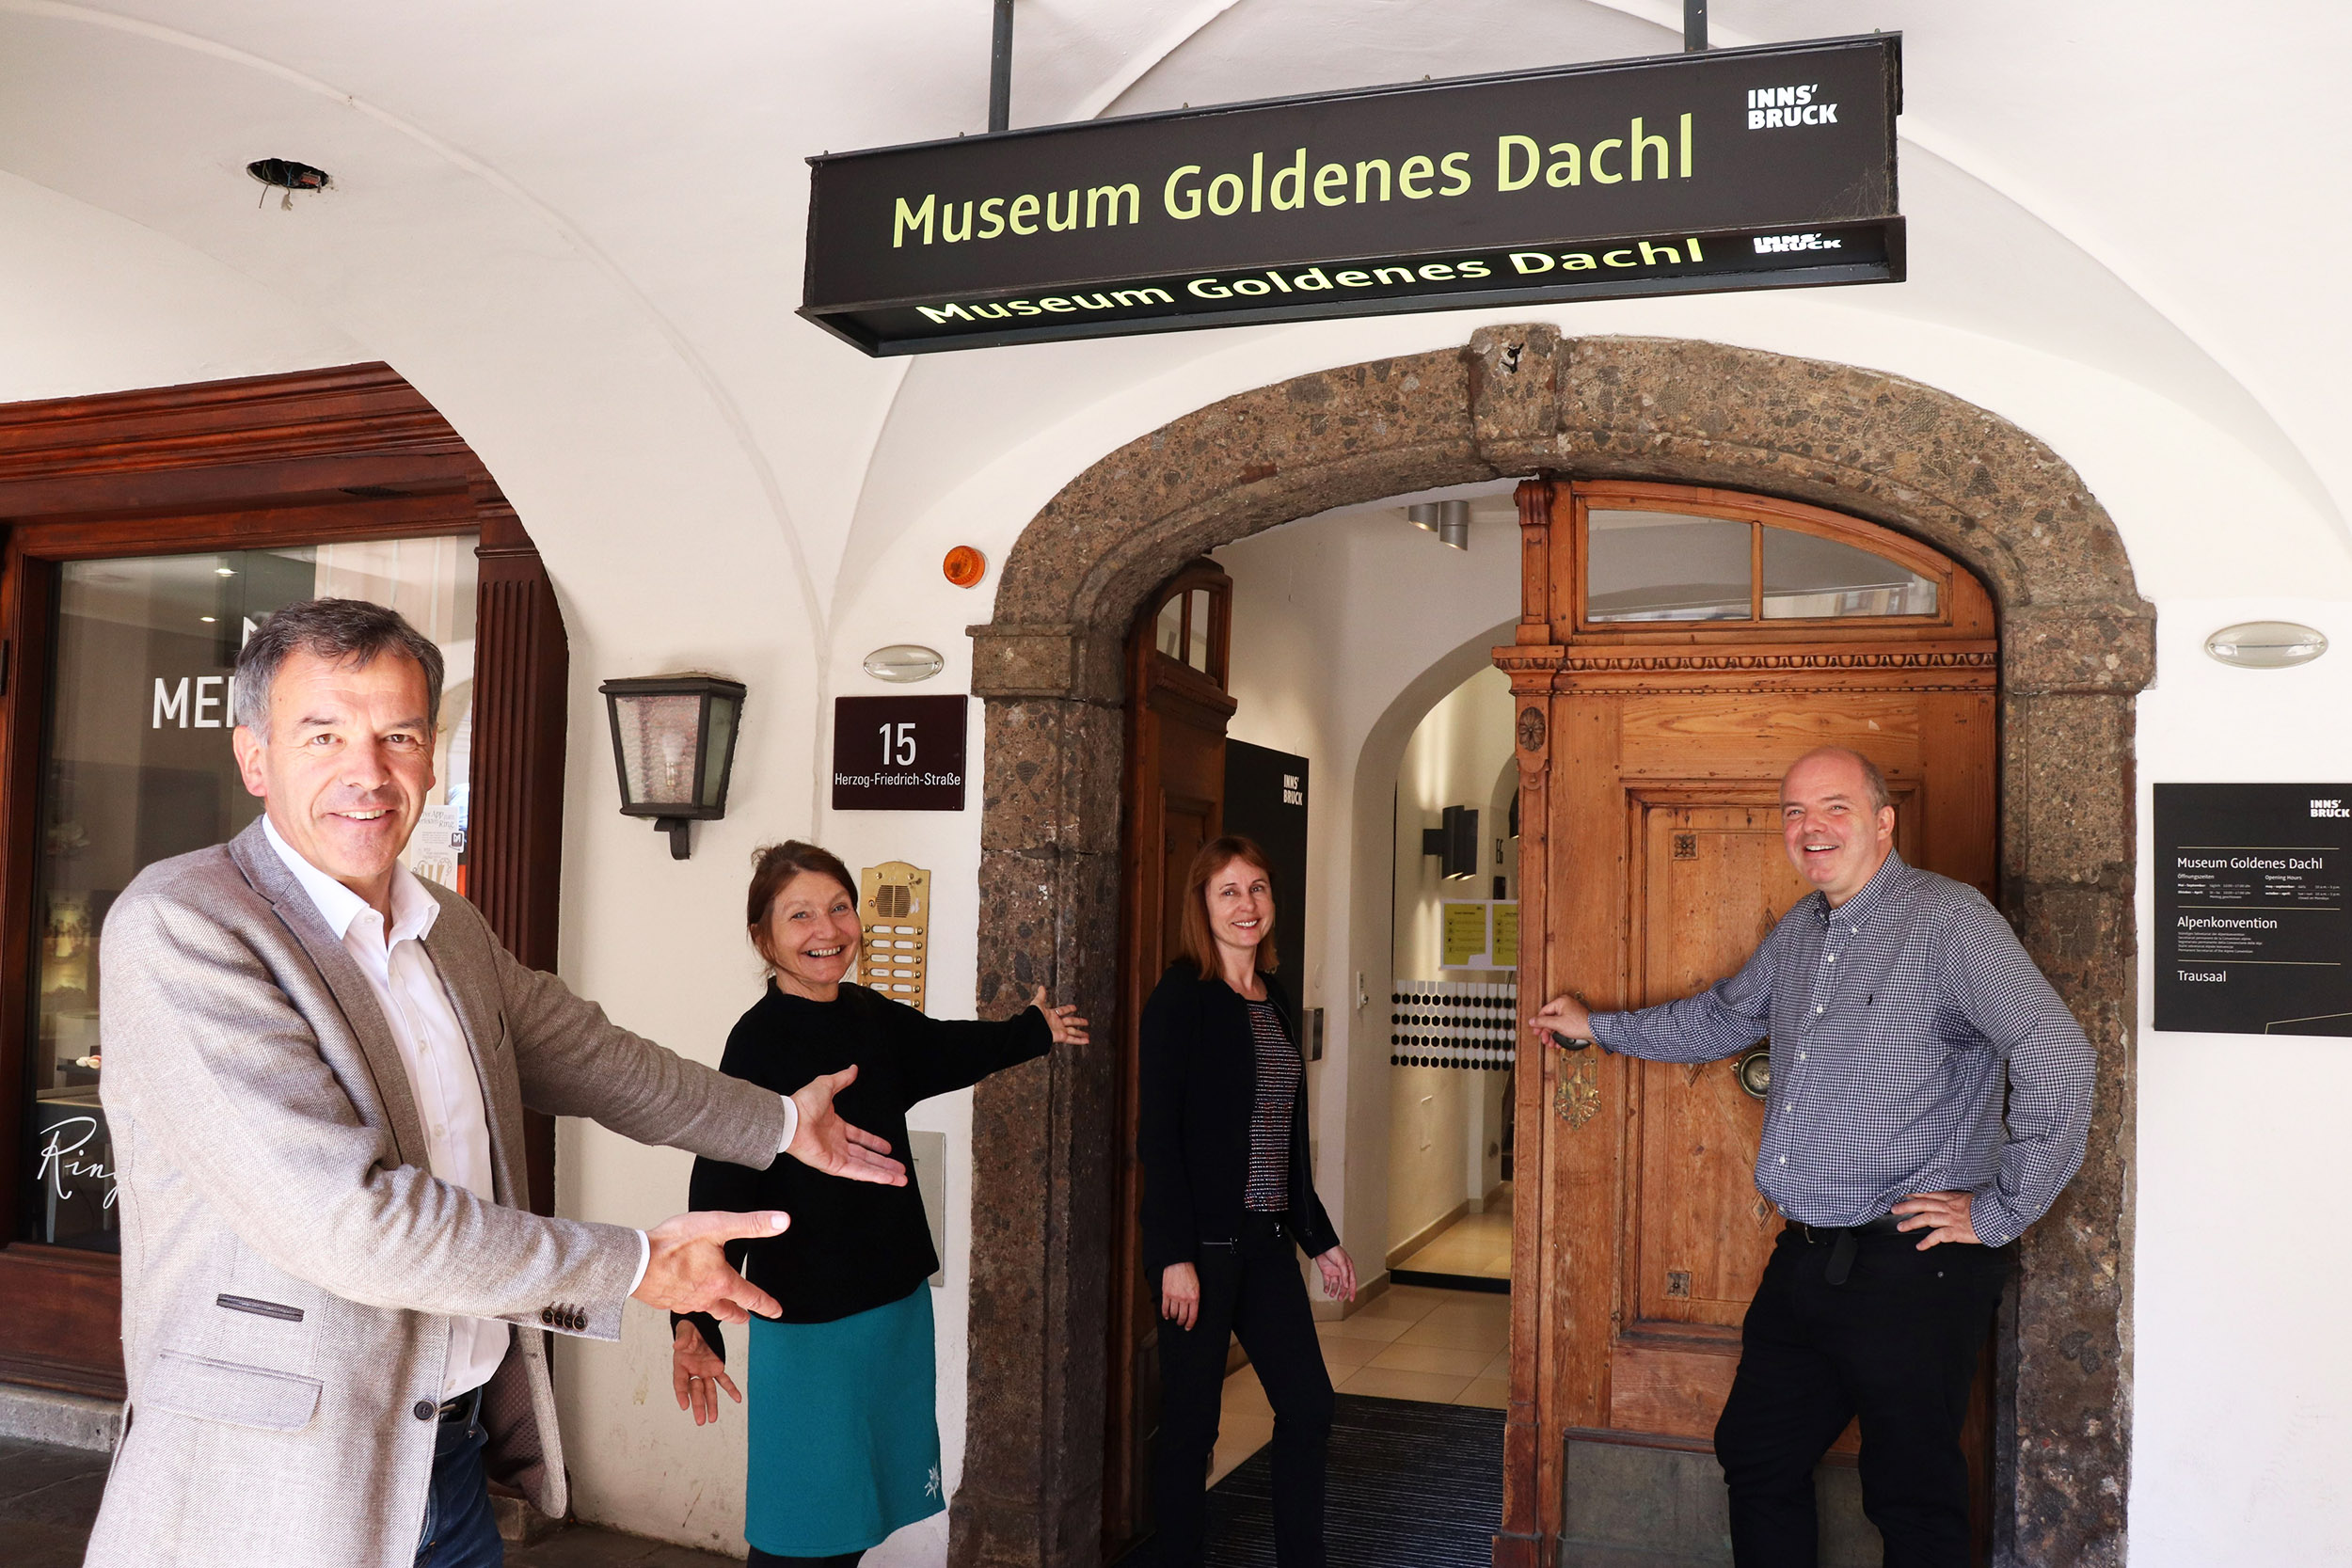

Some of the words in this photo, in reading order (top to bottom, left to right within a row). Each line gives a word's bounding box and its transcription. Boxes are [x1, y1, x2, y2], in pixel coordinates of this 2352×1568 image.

[1747, 103, 1837, 130] BRUCK
[893, 182, 1140, 249] Museum
[1164, 147, 1471, 220] Goldenes
[1498, 112, 1692, 192] Dachl
[915, 285, 1176, 325] Museum
[1187, 256, 1492, 299] Goldenes
[1509, 237, 1705, 276] Dachl
[879, 722, 916, 766] 15
[834, 772, 961, 788] Herzog-Friedrich-Straße
[1283, 789, 1303, 806] BRUCK
[2311, 808, 2351, 818] BRUCK
[2177, 857, 2228, 869] Museum
[2230, 857, 2286, 869] Goldenes
[2289, 857, 2323, 870] Dachl
[2177, 915, 2278, 930] Alpenkonvention
[2177, 970, 2227, 983] Trausaal
